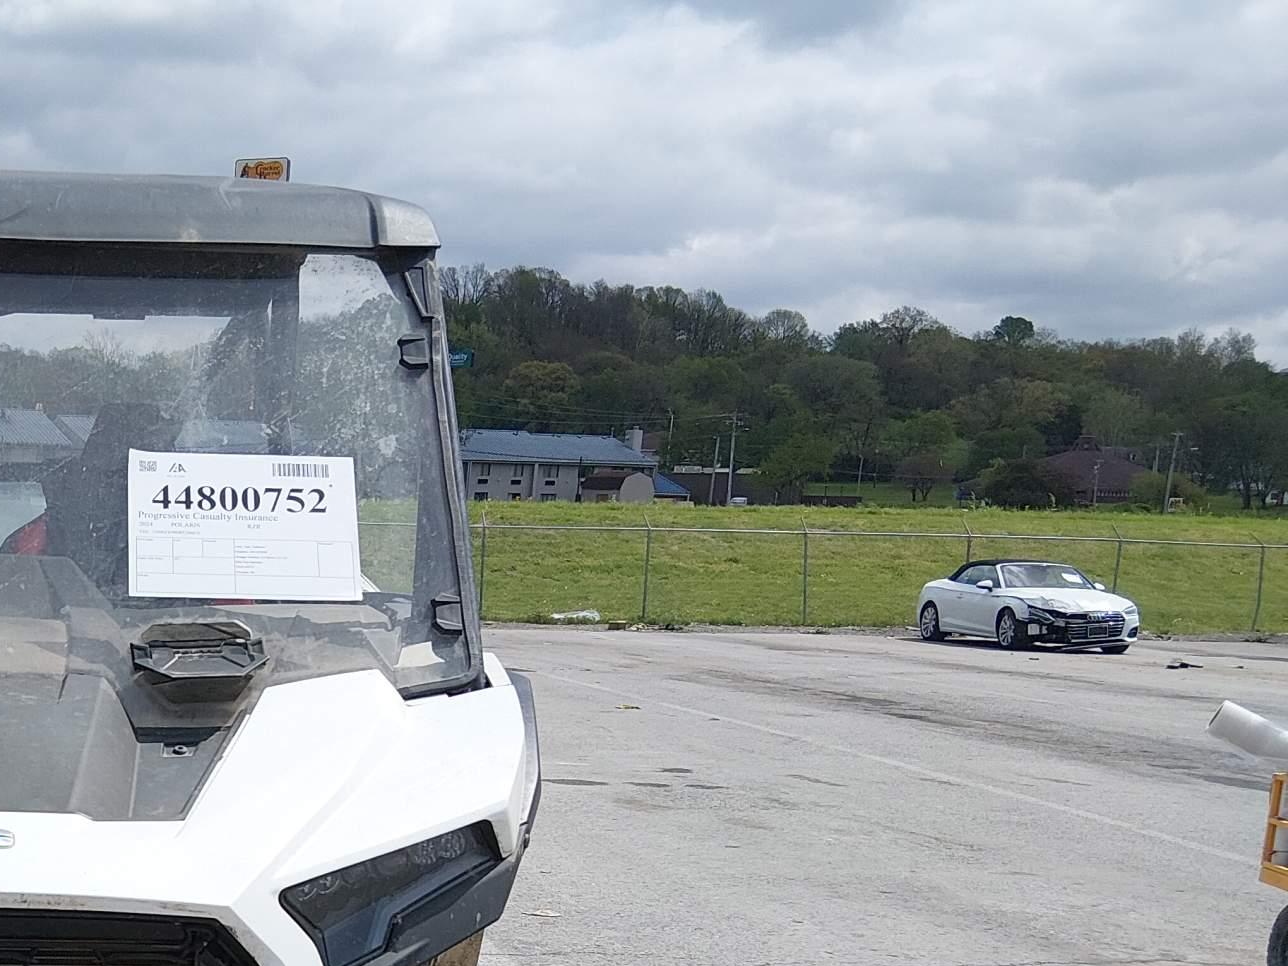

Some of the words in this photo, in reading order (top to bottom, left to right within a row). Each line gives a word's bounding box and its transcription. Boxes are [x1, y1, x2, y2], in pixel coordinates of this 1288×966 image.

[152, 484, 327, 513] 44800752
[138, 511, 191, 521] Progressive
[192, 512, 232, 522] Casualty
[235, 513, 279, 522] Insurance
